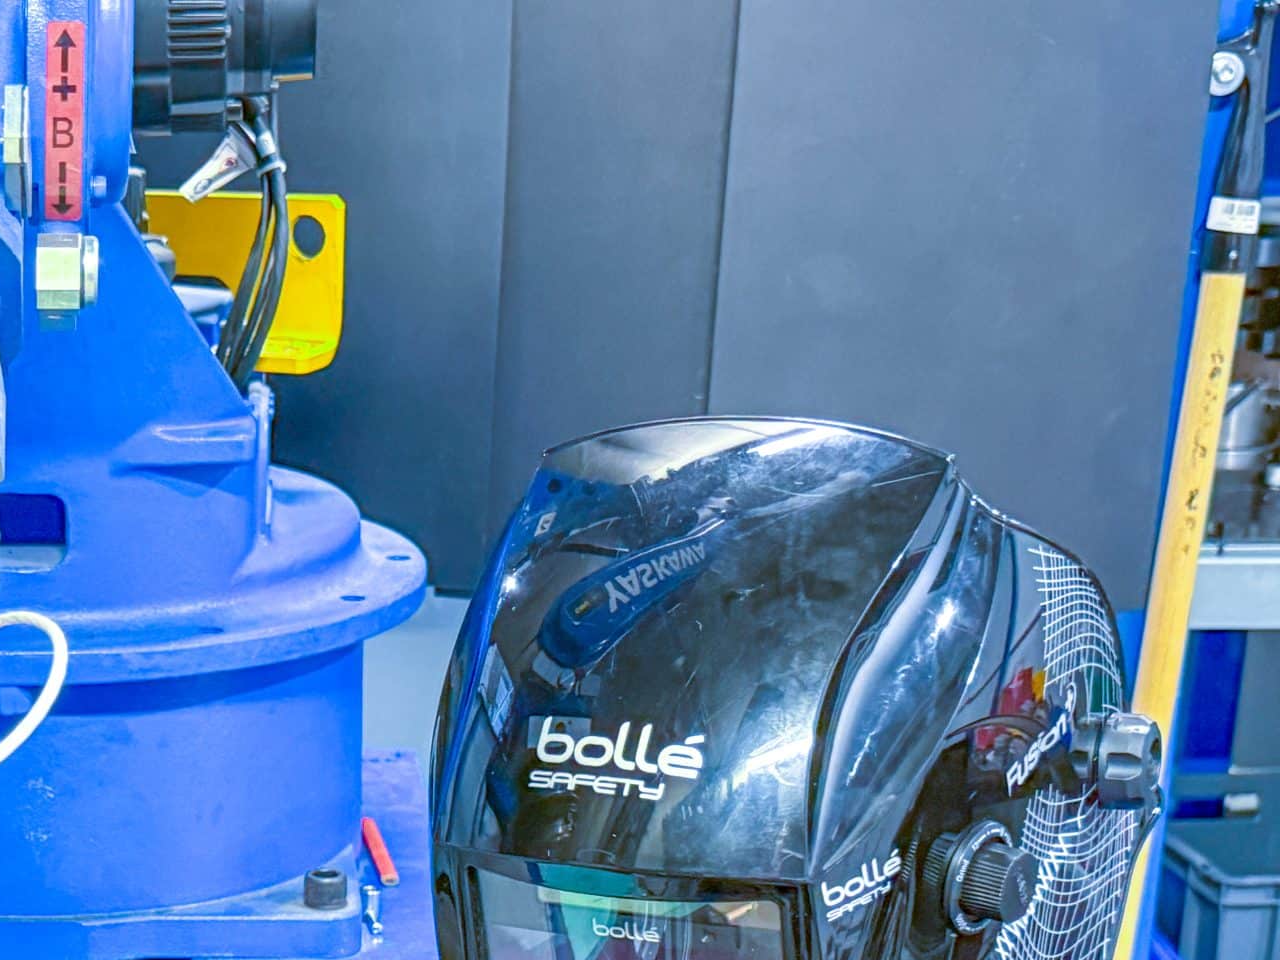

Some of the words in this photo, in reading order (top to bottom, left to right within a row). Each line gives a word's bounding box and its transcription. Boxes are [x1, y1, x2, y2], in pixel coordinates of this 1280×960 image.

[52, 117, 74, 148] B
[537, 715, 705, 779] bollé
[528, 769, 666, 801] SAFETY
[821, 848, 902, 906] bollé
[826, 881, 891, 922] SAFETY
[591, 917, 661, 943] bollé
